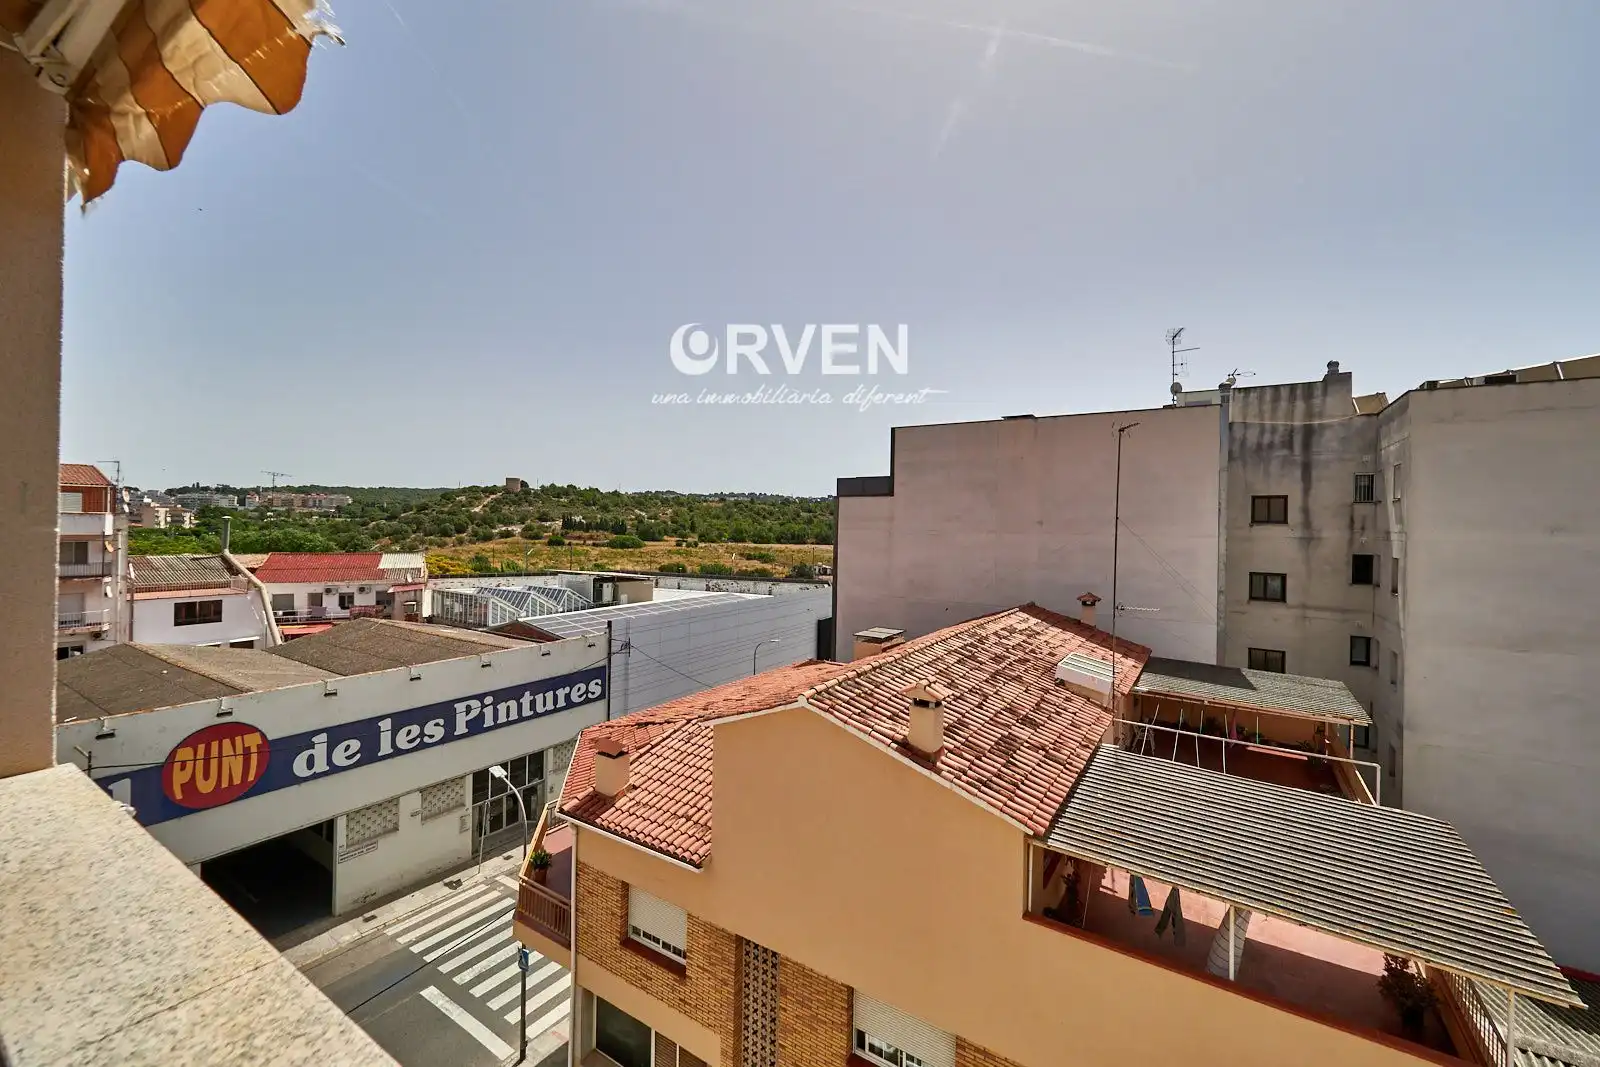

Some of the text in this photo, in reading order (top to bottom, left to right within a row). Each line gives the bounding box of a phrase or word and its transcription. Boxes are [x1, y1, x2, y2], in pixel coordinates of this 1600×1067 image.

[172, 732, 263, 800] PUNT
[292, 732, 362, 778] de
[377, 718, 445, 757] les
[453, 678, 602, 736] Pintures
